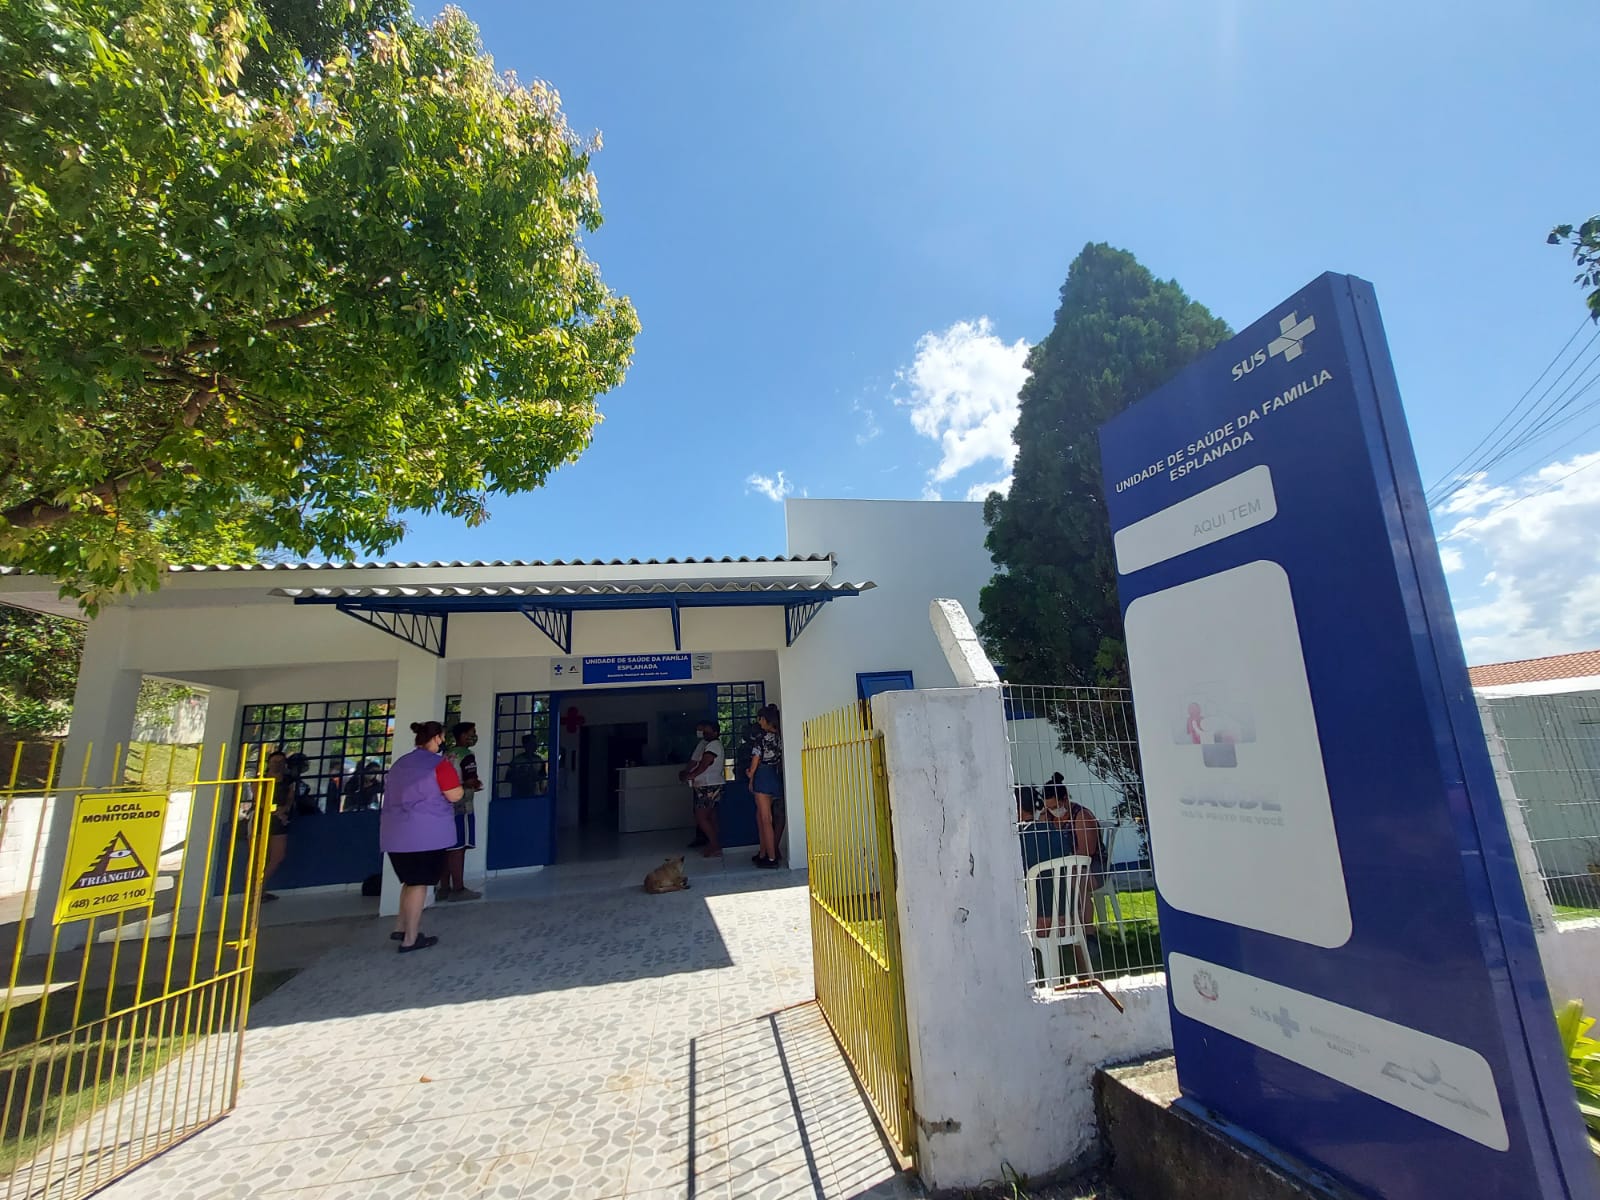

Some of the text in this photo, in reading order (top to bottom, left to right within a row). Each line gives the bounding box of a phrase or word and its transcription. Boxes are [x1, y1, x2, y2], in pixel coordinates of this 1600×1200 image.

[1231, 349, 1266, 382] SUS
[1115, 369, 1334, 494] UNIDADE DE SAÚDE DA FAMILIA
[1169, 431, 1254, 482] ESPLANADA
[1193, 498, 1261, 537] AQUI TEM
[617, 663, 658, 671] ESPLANADA
[627, 655, 650, 664] SAÚDE
[82, 810, 160, 824] MONITORADO
[106, 803, 141, 813] LOCAL
[79, 869, 145, 887] TRIÂNGULO
[68, 888, 146, 912] (48) 2102 1100
